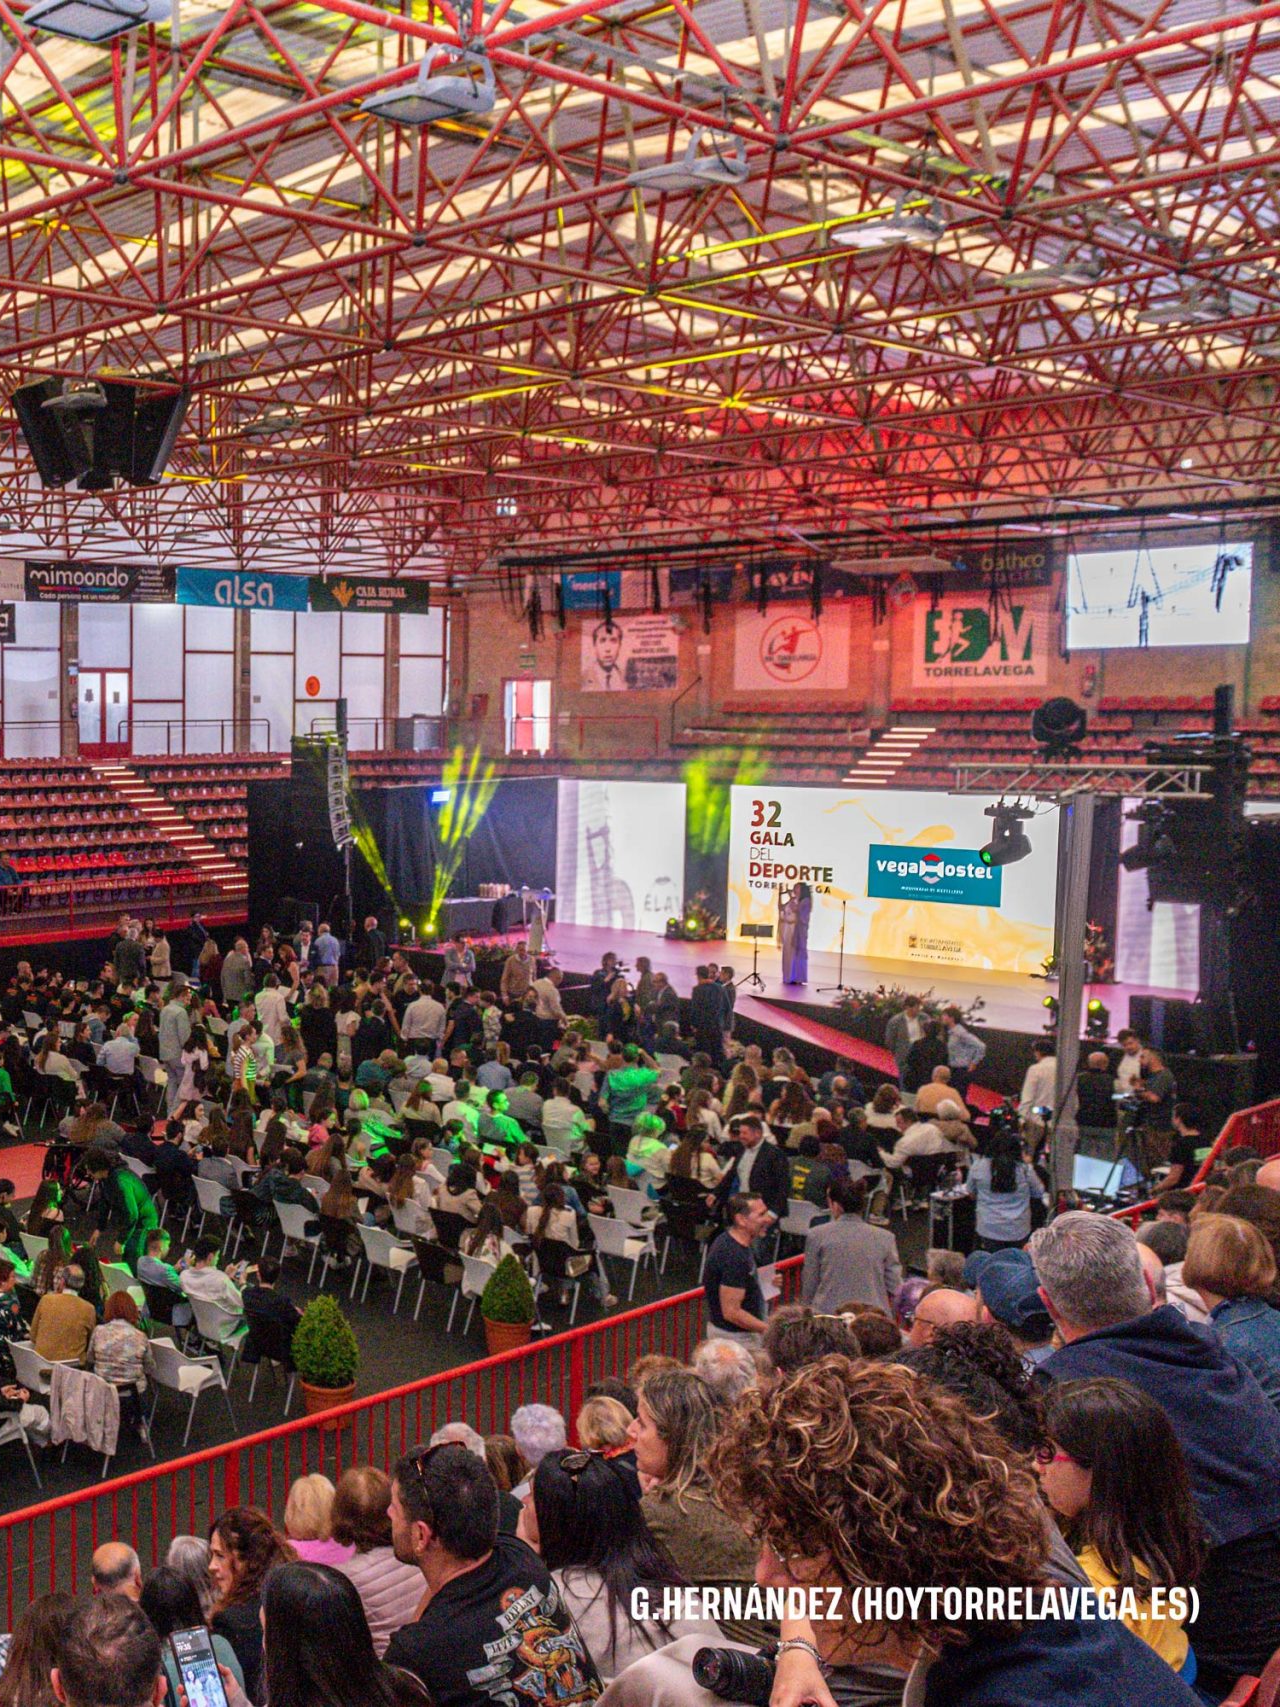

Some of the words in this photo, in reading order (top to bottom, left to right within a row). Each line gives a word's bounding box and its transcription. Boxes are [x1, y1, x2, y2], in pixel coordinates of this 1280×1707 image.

[29, 565, 129, 587] mimoondo
[214, 575, 274, 607] alsa
[924, 665, 1035, 678] TORRELAVEGA
[750, 800, 782, 828] 32
[750, 830, 795, 847] GALA
[749, 847, 775, 861] DEL
[749, 862, 834, 883] DEPORTE
[748, 880, 832, 894] TORRELEGA
